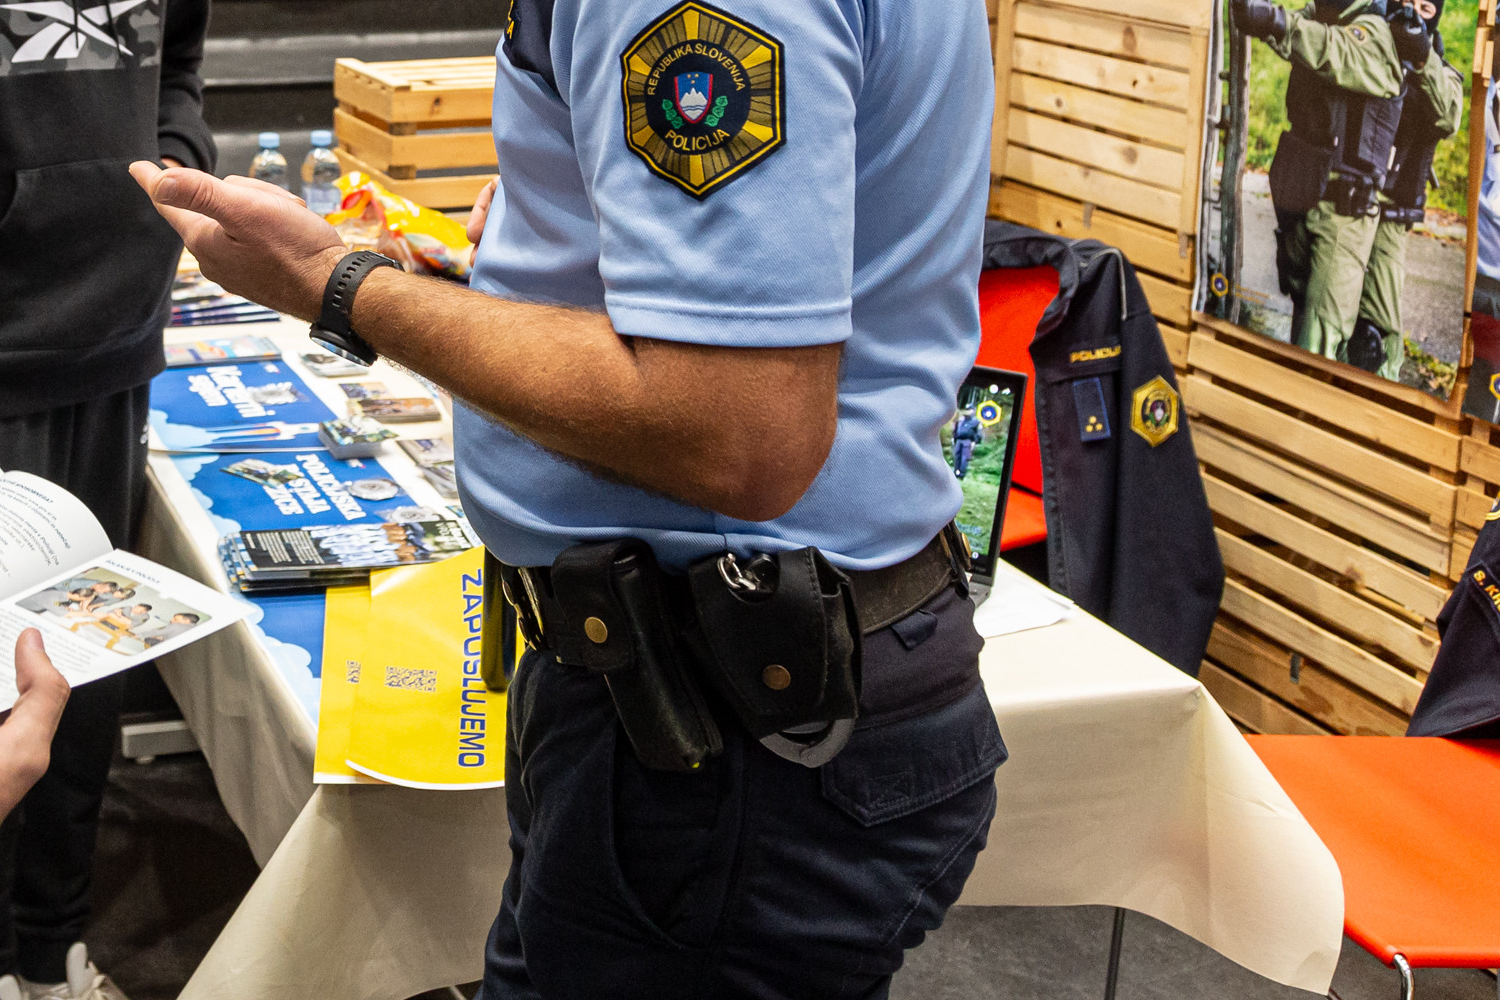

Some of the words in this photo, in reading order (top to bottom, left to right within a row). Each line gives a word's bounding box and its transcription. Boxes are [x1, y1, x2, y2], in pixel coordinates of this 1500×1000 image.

[647, 43, 693, 96] REPUBLIKA
[694, 43, 746, 91] SLOVENIJA
[665, 128, 730, 151] POLICIJA
[277, 463, 331, 514] PSTAJA
[295, 453, 367, 521] POLICIJSKA
[458, 569, 487, 768] ZAPOSLUJEMO
